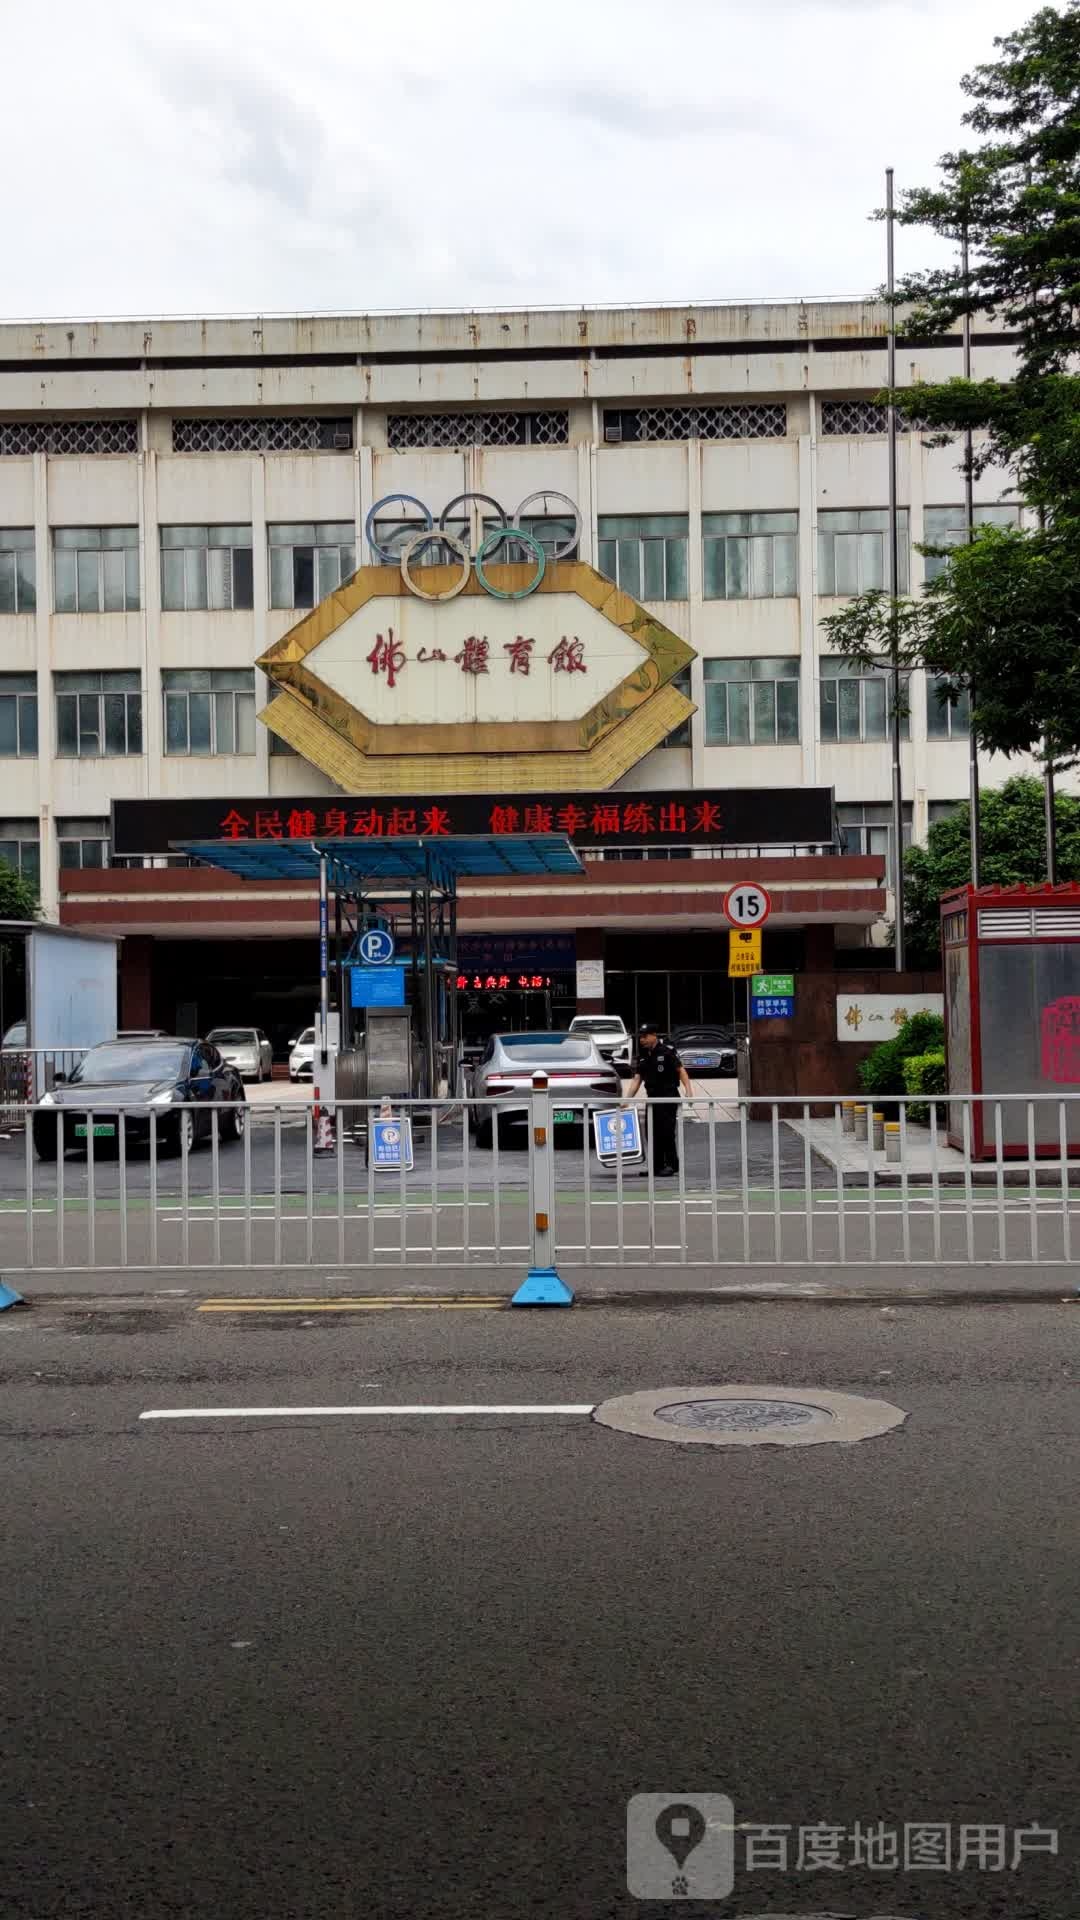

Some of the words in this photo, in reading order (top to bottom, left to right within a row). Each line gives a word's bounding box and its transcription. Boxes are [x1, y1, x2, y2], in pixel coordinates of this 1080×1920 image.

[220, 806, 450, 840] 全民健身动起来
[489, 800, 724, 835] 健康幸福练出来
[735, 895, 760, 917] 15
